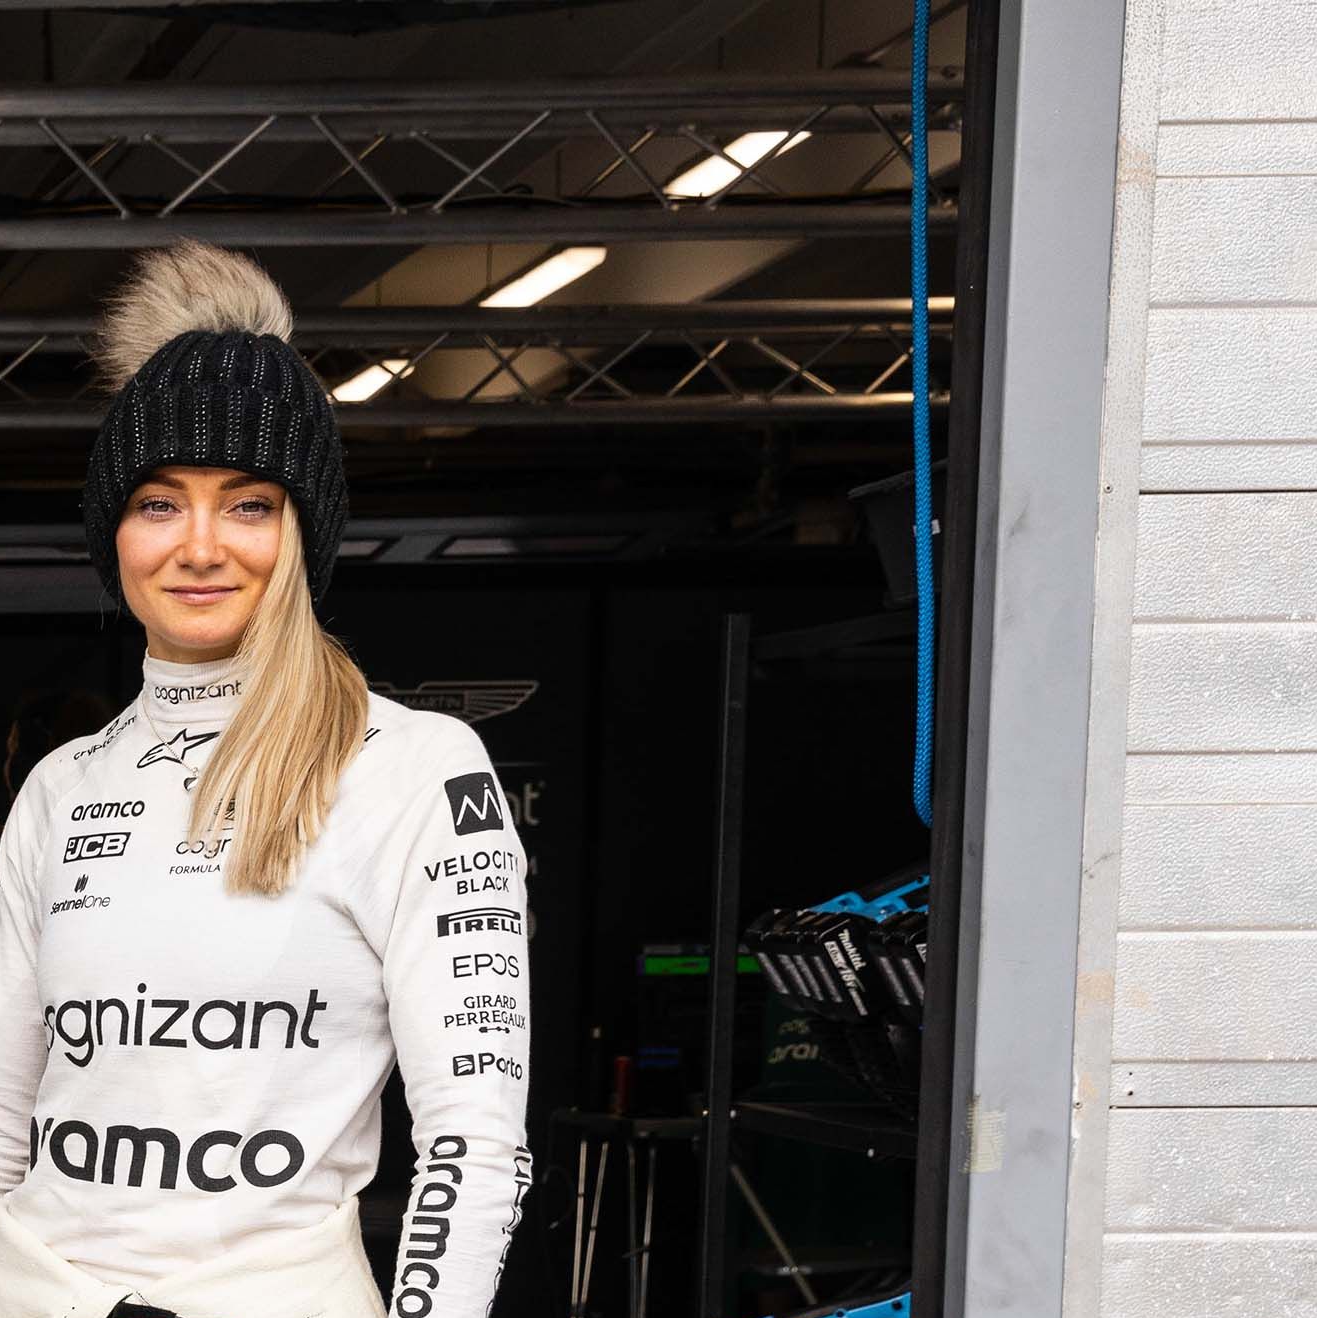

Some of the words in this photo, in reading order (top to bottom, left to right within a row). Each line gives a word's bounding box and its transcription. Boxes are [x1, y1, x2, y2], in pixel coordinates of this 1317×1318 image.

[155, 680, 242, 704] cognizant
[71, 800, 145, 821] aramco
[64, 832, 129, 862] JCB
[169, 864, 221, 875] FORMULA
[457, 876, 509, 895] BLACK
[50, 895, 111, 915] SentinelOne
[437, 907, 522, 937] PIRELLI
[453, 953, 520, 978] EPOS
[464, 994, 517, 1010] GIRARD
[44, 983, 327, 1068] gnizant
[444, 1010, 526, 1030] PERREGAUX
[478, 1053, 523, 1080] Porto
